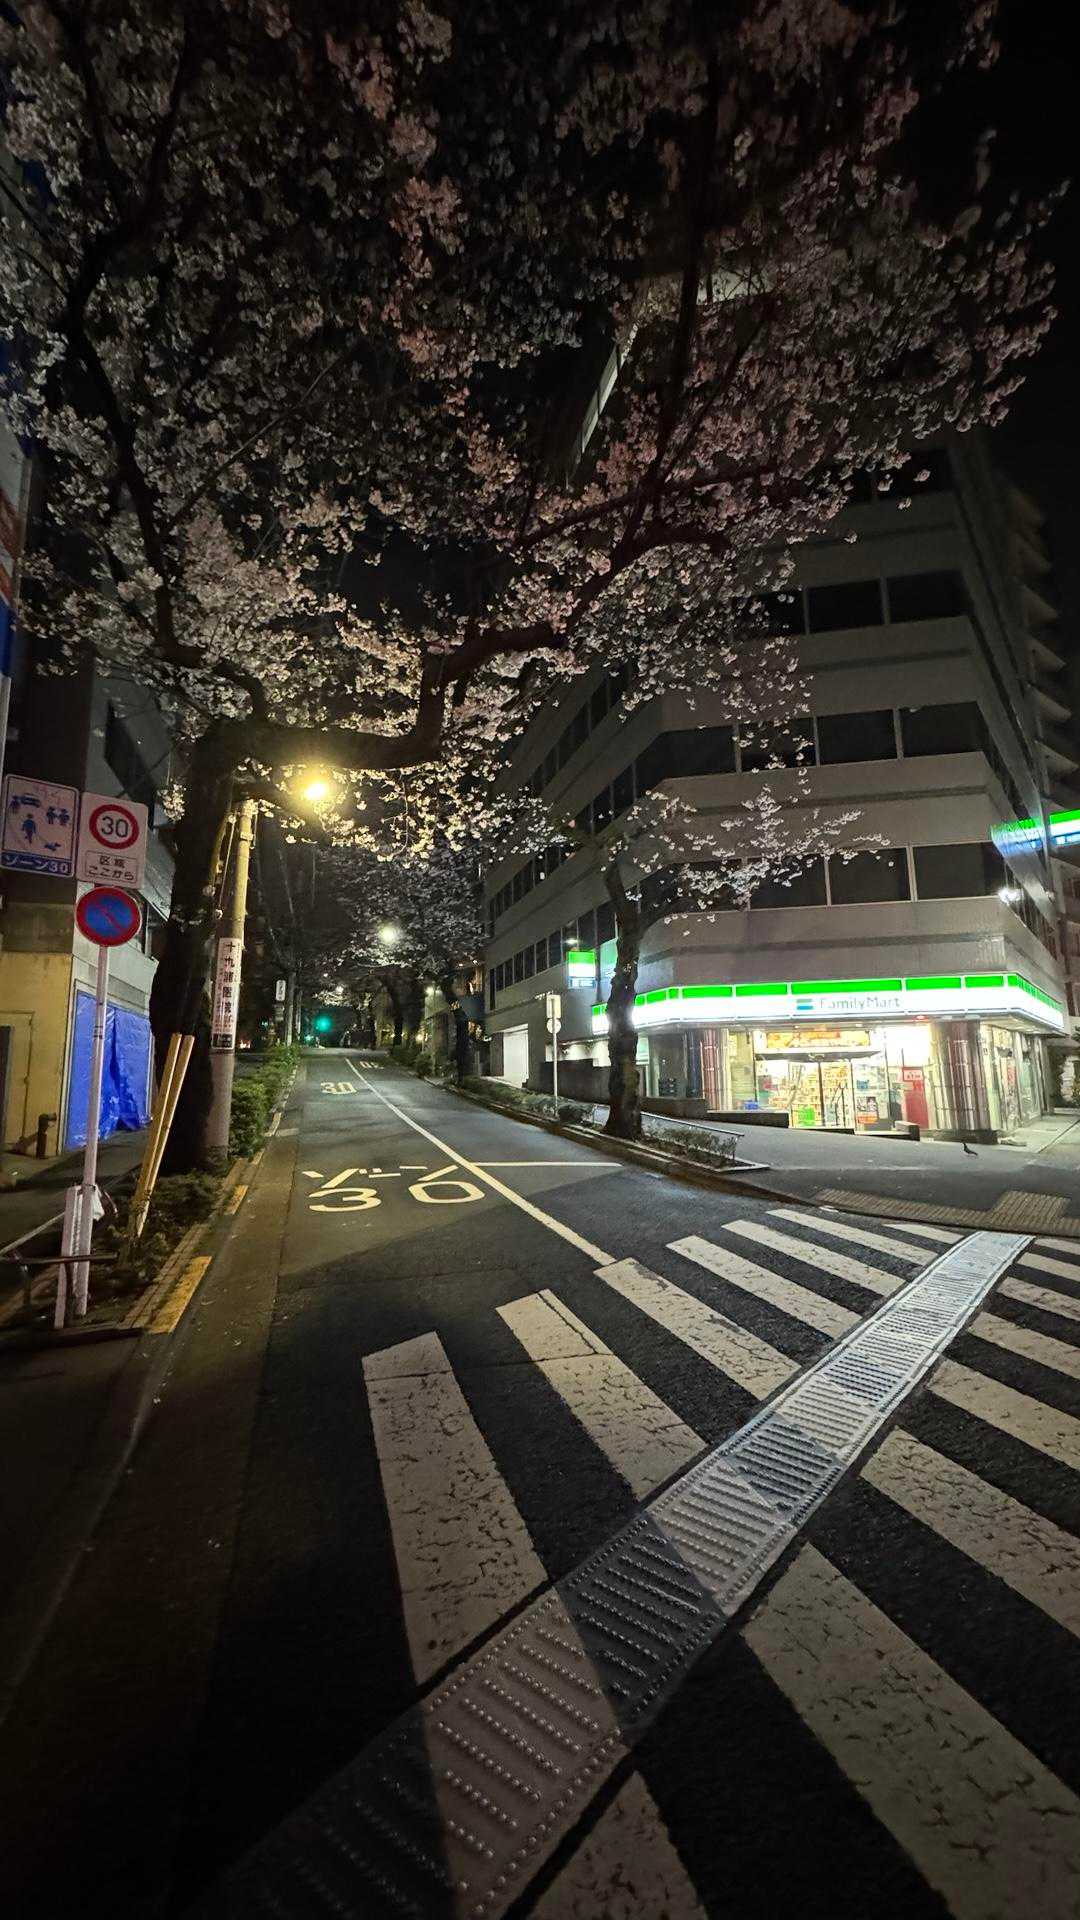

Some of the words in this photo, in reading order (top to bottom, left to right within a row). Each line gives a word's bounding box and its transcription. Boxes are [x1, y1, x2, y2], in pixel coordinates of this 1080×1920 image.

[101, 816, 129, 838] 30
[5, 855, 69, 874] ゾーン30
[88, 865, 134, 881] ここから
[820, 996, 900, 1010] FamilyMart
[320, 1082, 357, 1095] 30
[302, 1167, 459, 1189] ゾーン
[309, 1181, 486, 1213] 30
